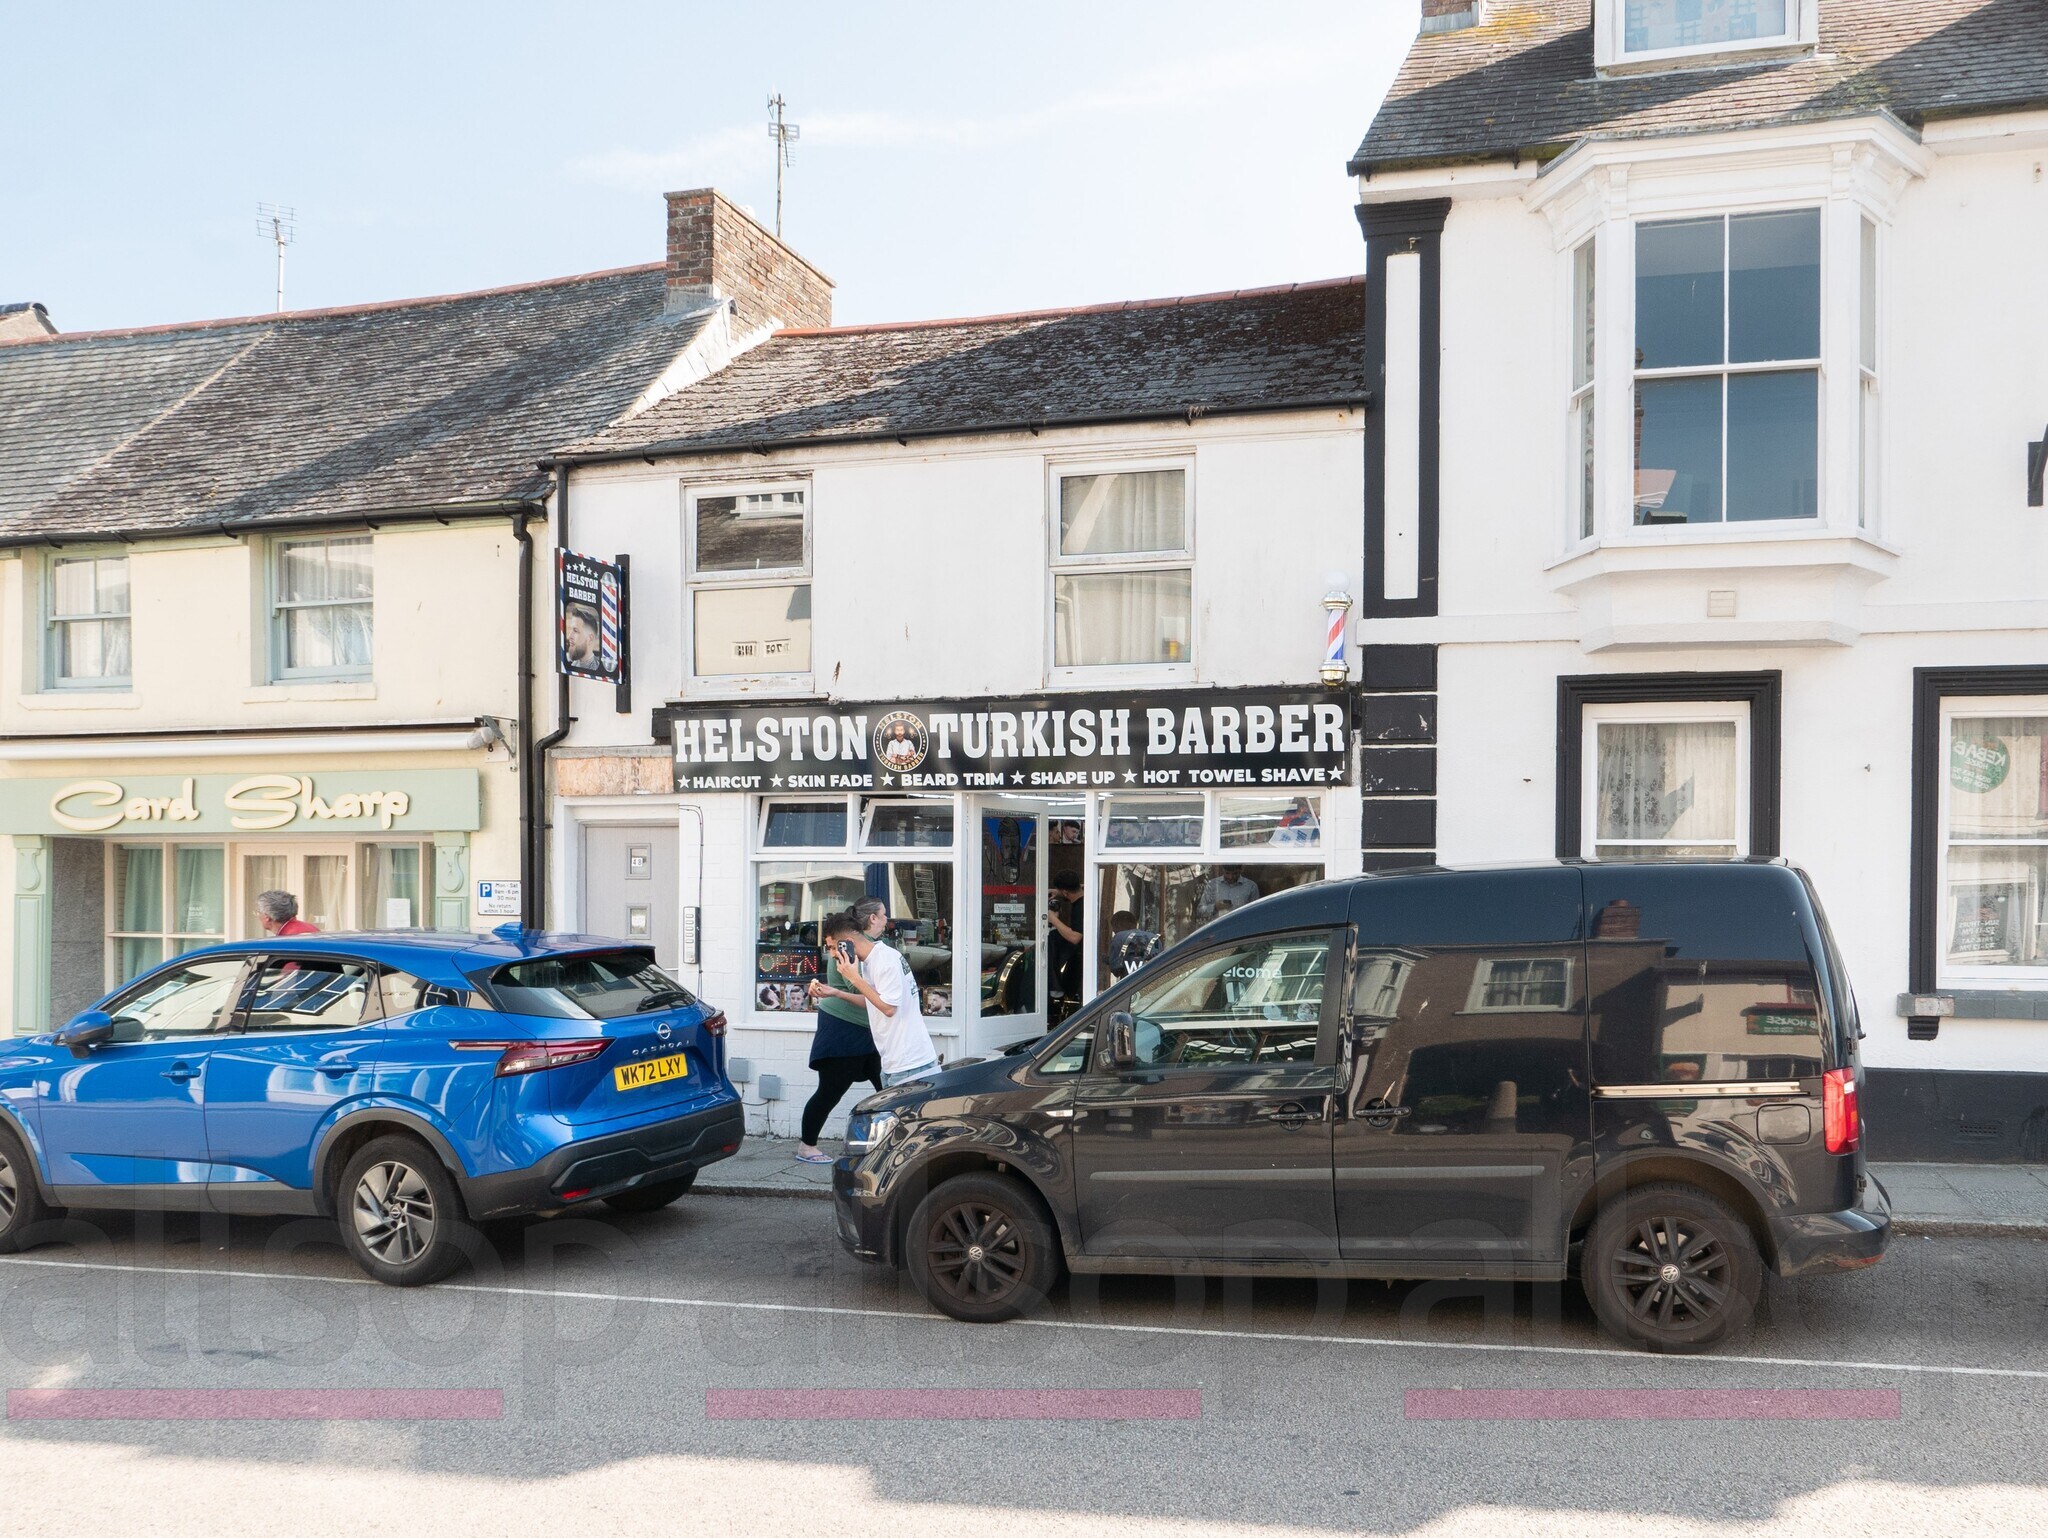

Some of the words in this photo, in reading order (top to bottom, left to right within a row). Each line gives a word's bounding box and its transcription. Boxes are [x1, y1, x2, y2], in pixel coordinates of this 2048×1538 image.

[566, 571, 599, 590] HELSTON
[568, 587, 597, 604] BARBER
[674, 715, 868, 763] HELSTON
[929, 708, 1131, 759] TURKISH
[1147, 704, 1345, 755] BARBER
[693, 775, 762, 789] HAIRCUT
[788, 775, 825, 788] SKIN
[830, 774, 873, 787] FADE
[901, 773, 959, 786] BEARD
[963, 772, 1004, 786] TRIM
[1031, 771, 1092, 785] SHAPE
[1095, 771, 1115, 784] UP
[1143, 770, 1180, 784] HOT
[1188, 769, 1256, 783] TOWEL
[1261, 768, 1325, 782] SHAVE
[50, 777, 200, 831] Card
[225, 774, 409, 830] Sharp
[758, 953, 818, 974] OPEN
[1222, 966, 1282, 979] elcome
[621, 1063, 657, 1086] WK72
[658, 1057, 681, 1078] LXY
